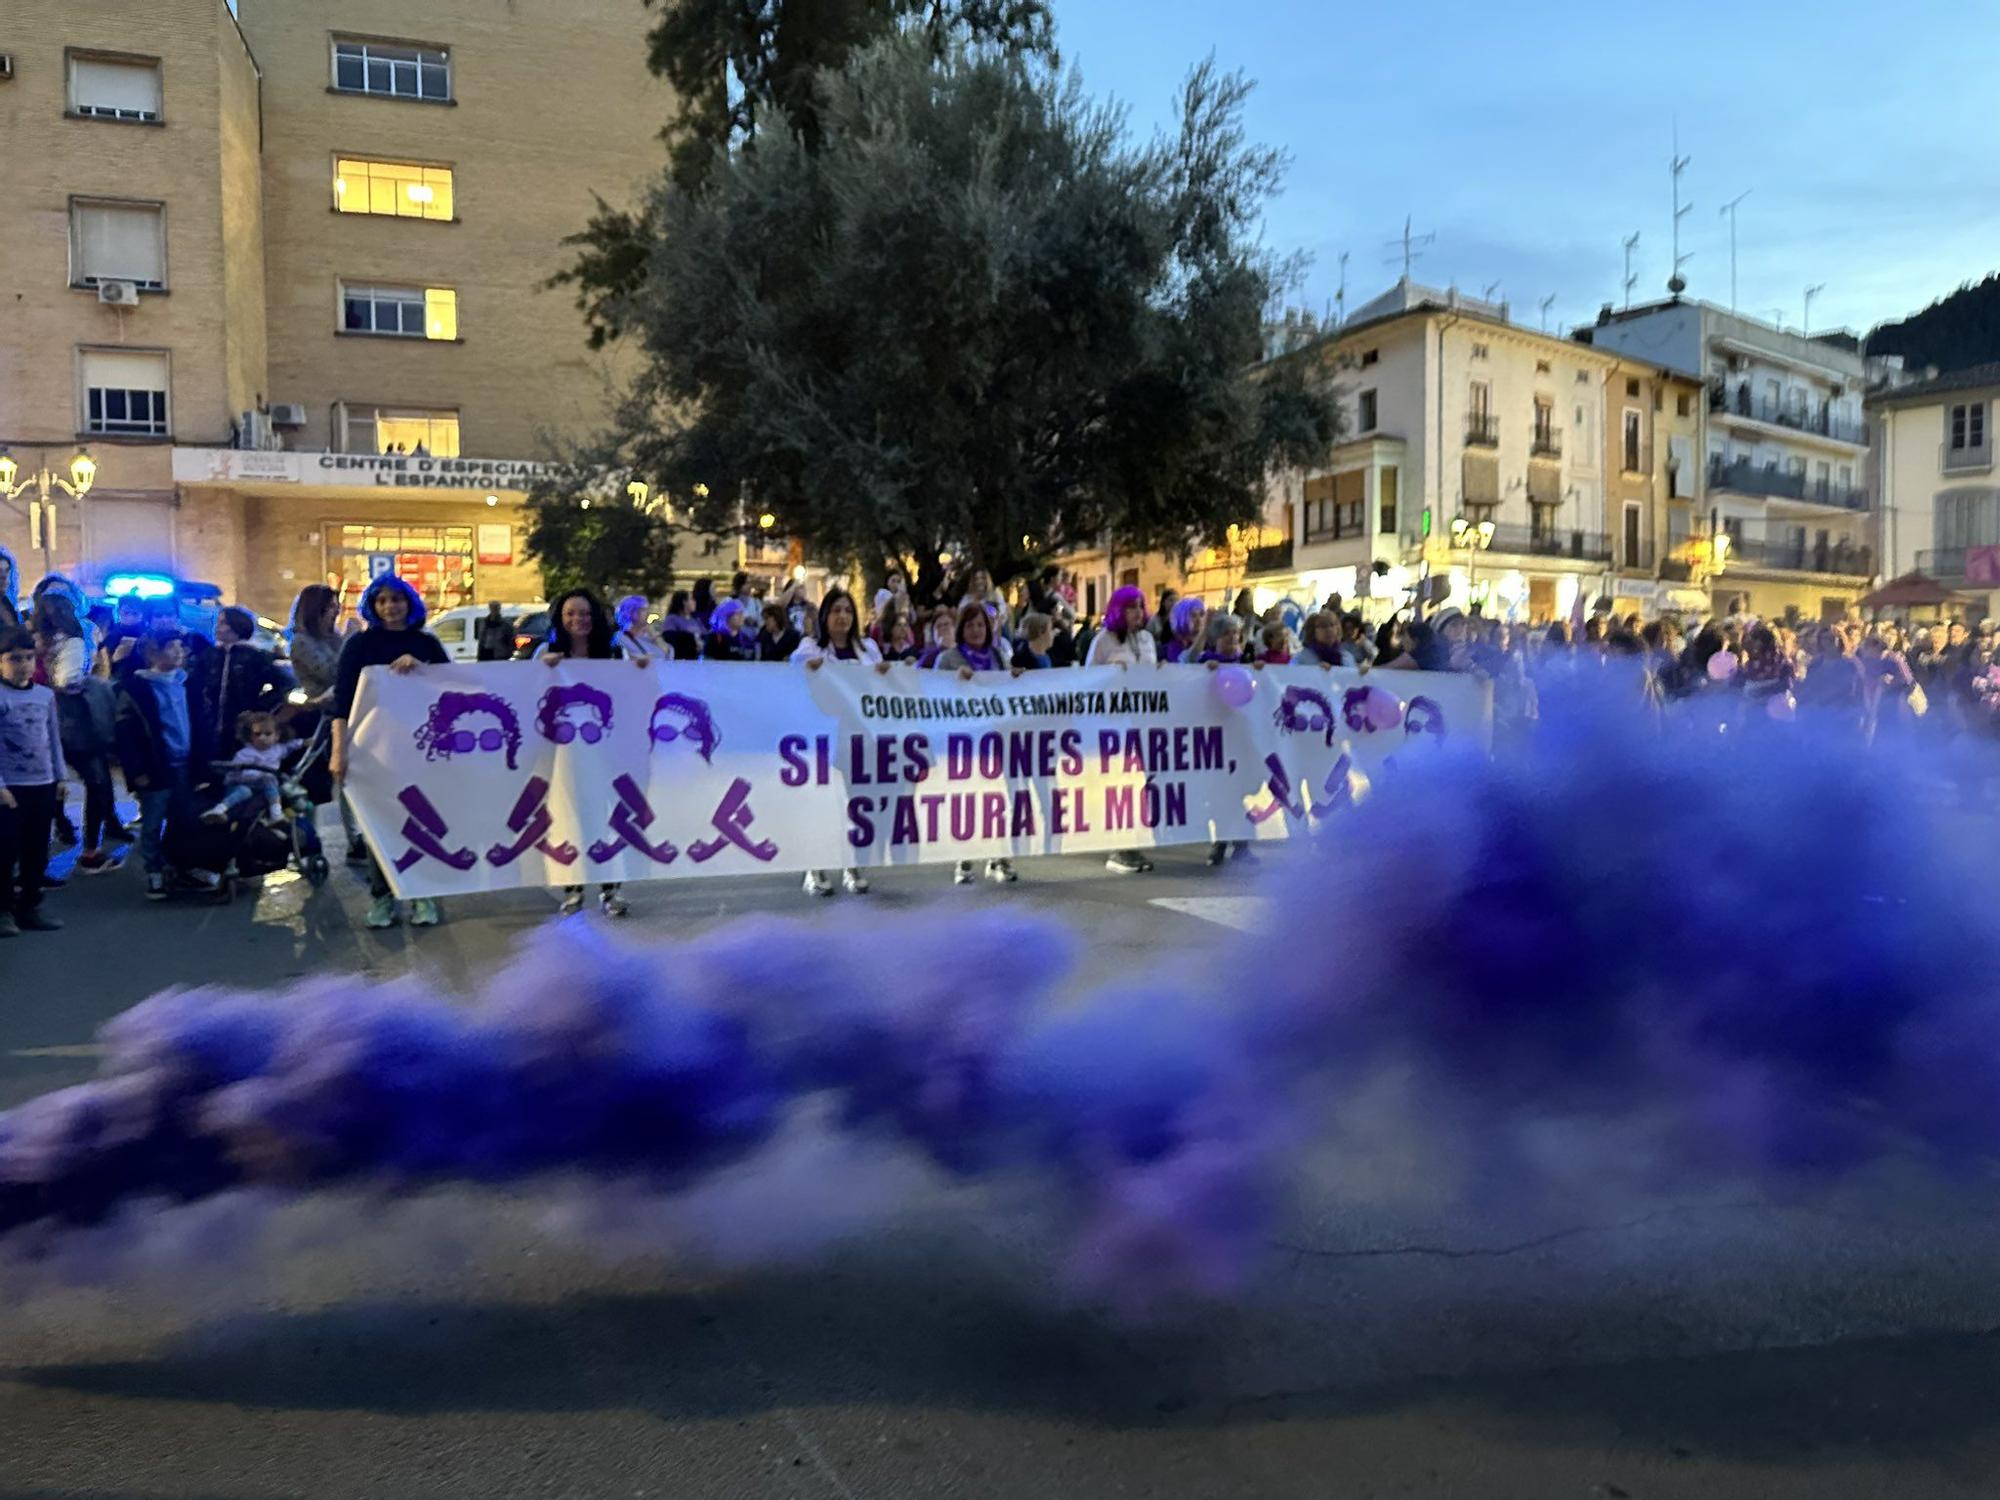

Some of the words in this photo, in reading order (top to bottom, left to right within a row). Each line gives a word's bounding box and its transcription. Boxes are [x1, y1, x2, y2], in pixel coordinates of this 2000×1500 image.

[319, 456, 408, 471] CENTRE
[373, 557, 391, 580] P
[861, 693, 1004, 719] COORDINACIÓ
[1008, 692, 1105, 716] FEMINISTA
[1109, 688, 1169, 714] XÀTIVA
[778, 733, 830, 787] SI
[850, 732, 930, 784] LES
[947, 729, 1084, 781] DONES
[1098, 726, 1237, 775] PAREM,
[847, 788, 1036, 848] S'ATURA
[1051, 786, 1091, 835] EL
[1104, 774, 1187, 831] MÓN
